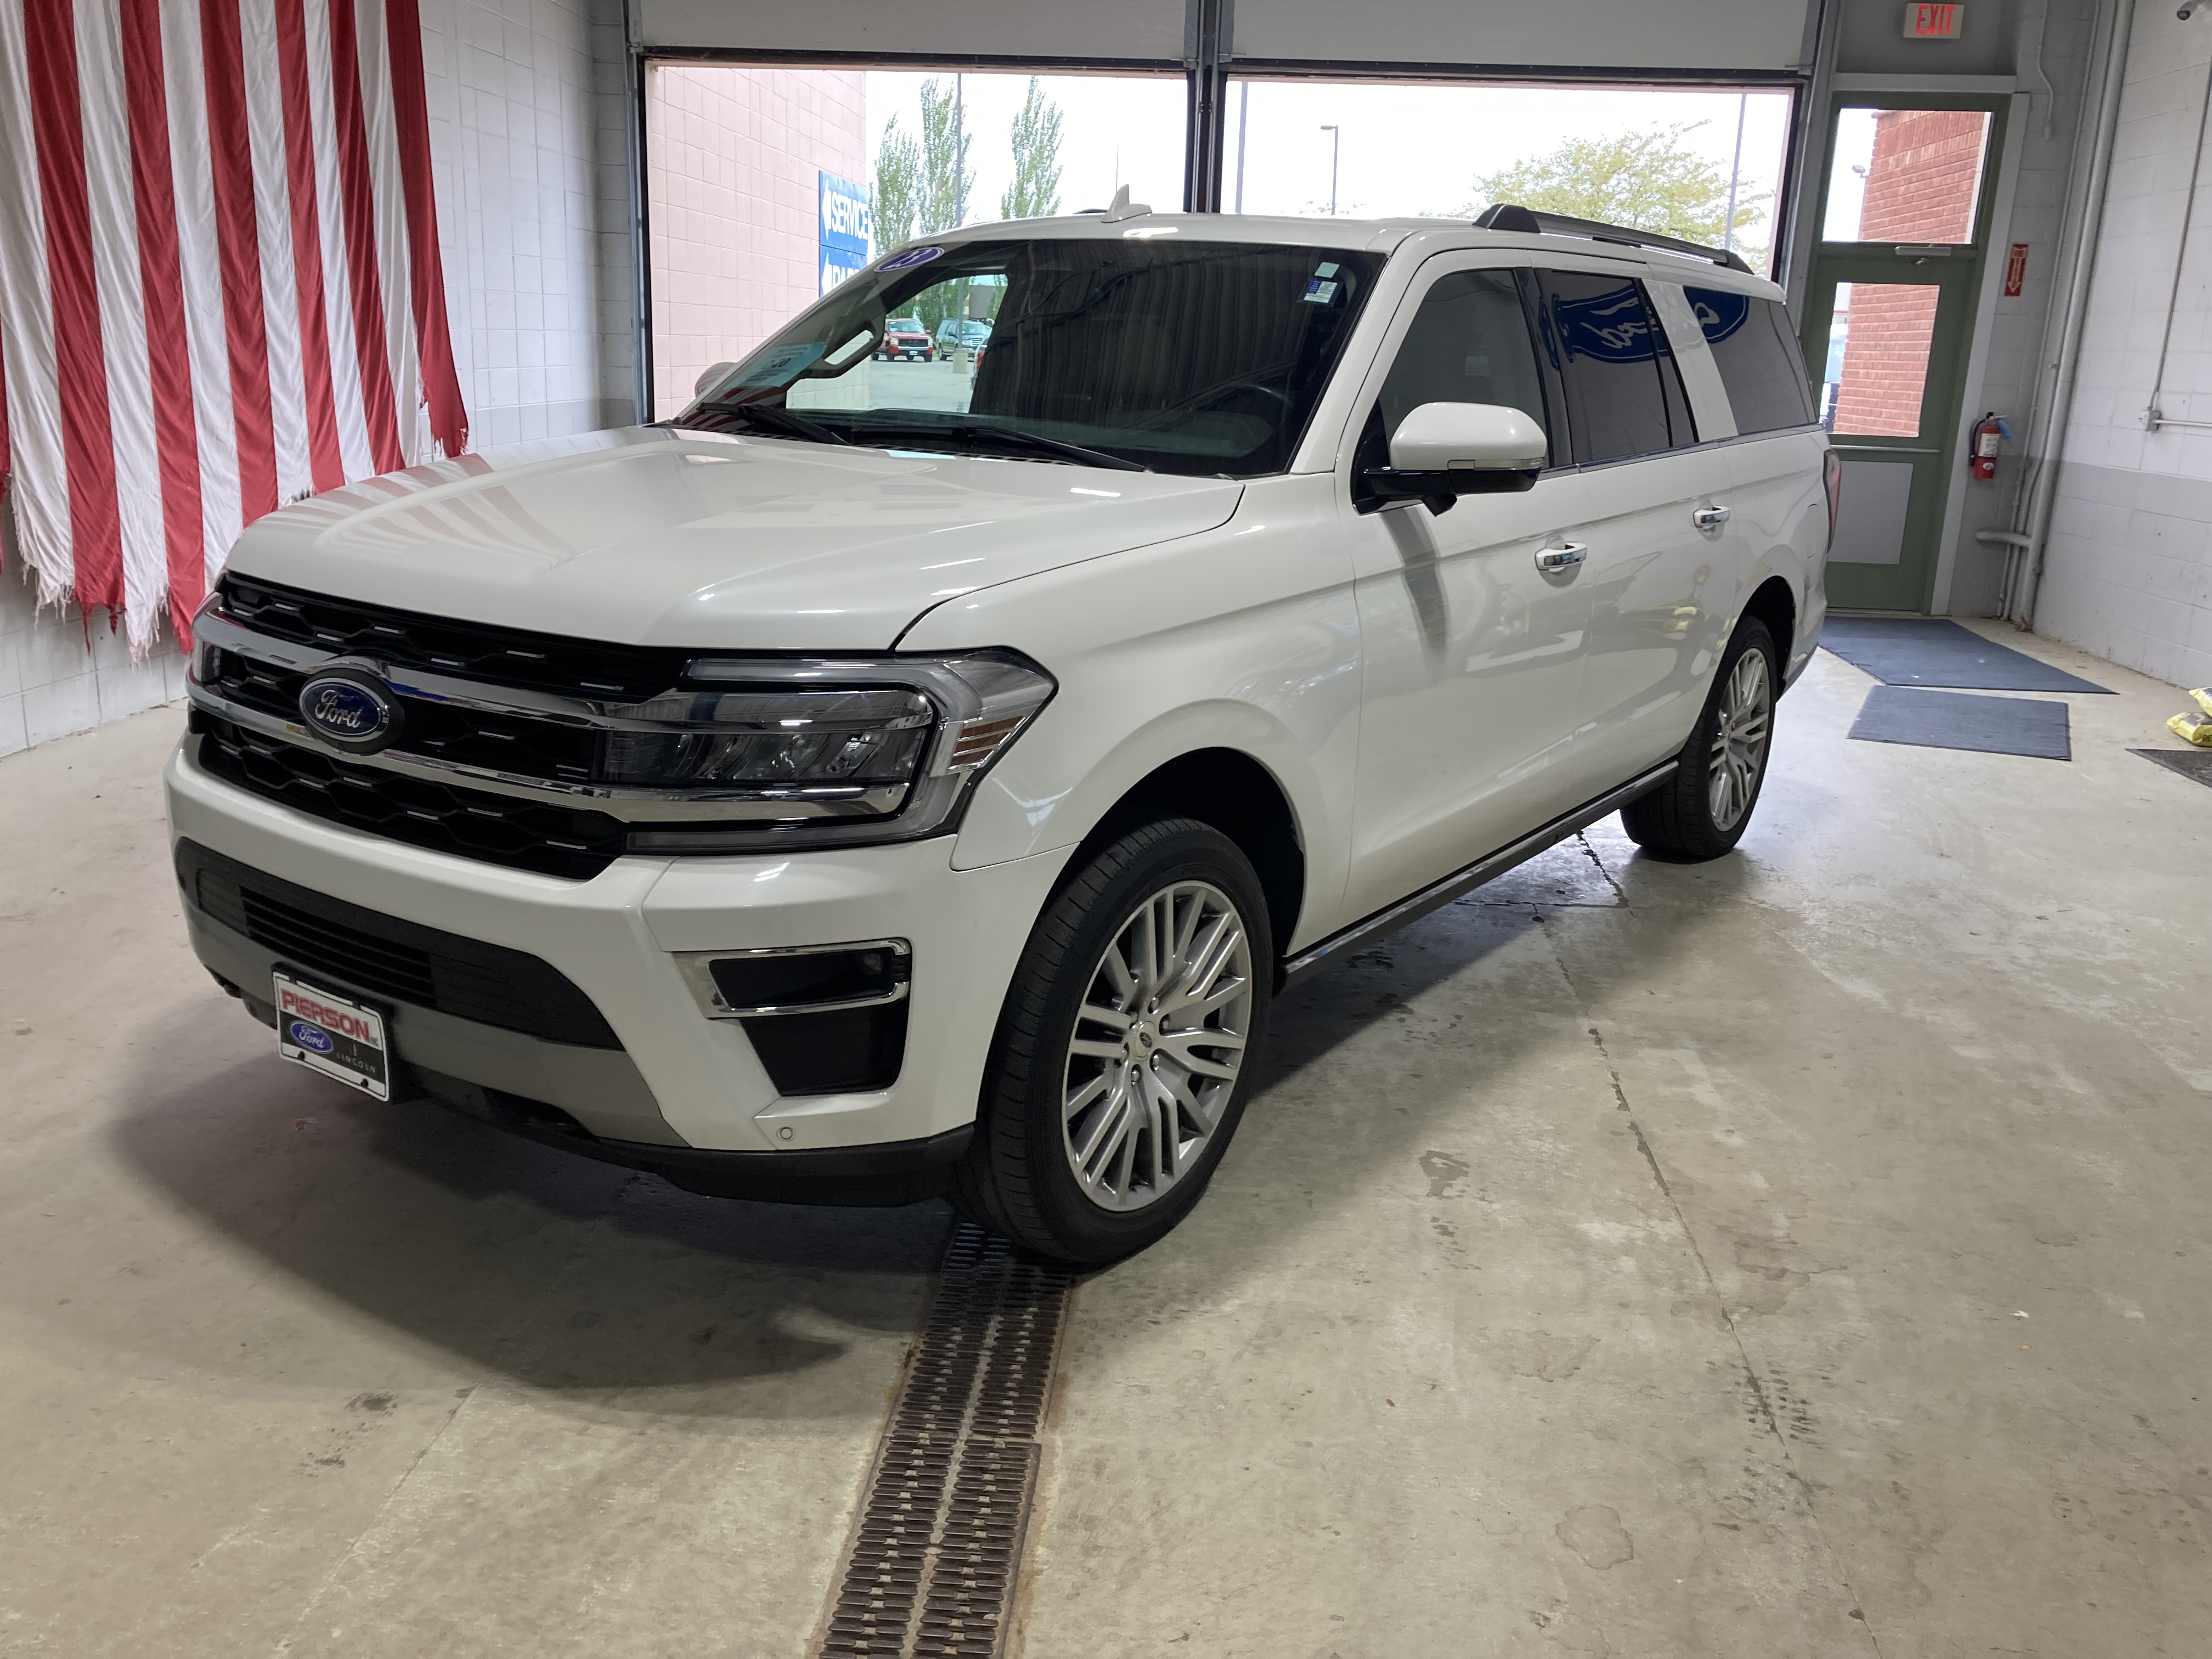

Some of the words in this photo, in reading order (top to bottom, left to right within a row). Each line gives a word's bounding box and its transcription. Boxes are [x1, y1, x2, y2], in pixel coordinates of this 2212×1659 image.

[1915, 4, 1956, 35] EXIT
[832, 191, 868, 240] SERVICE
[314, 689, 364, 728] Ford
[280, 988, 370, 1042] PIERSON
[298, 1025, 325, 1049] Ford
[336, 1051, 376, 1074] LINCOLN
